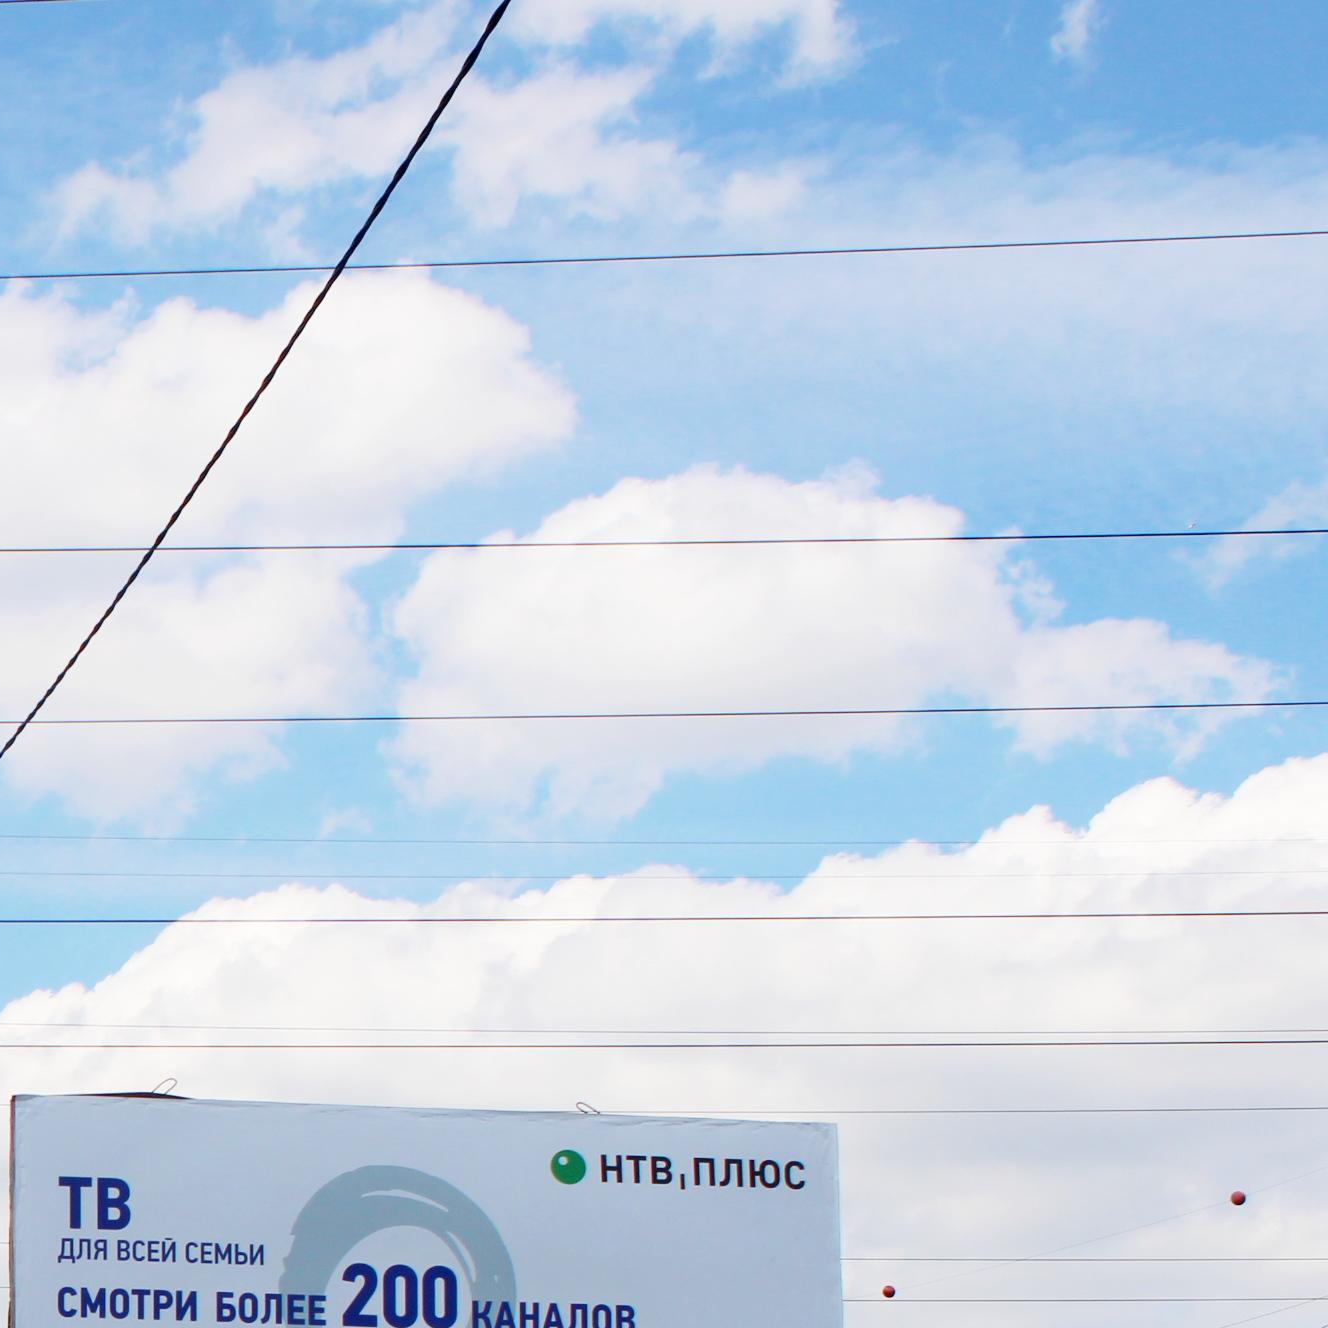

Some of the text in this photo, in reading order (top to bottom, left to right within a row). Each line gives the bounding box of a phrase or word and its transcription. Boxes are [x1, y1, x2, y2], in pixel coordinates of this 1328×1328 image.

[600, 1154, 806, 1190] НТВ ПЛЮС
[58, 1176, 132, 1231] ТВ
[57, 1237, 265, 1266] ДЛЯ ВСЕЙ СЕМЬИ
[57, 1286, 198, 1322] СМОТРИ
[216, 1291, 327, 1326] БОЛЕЕ
